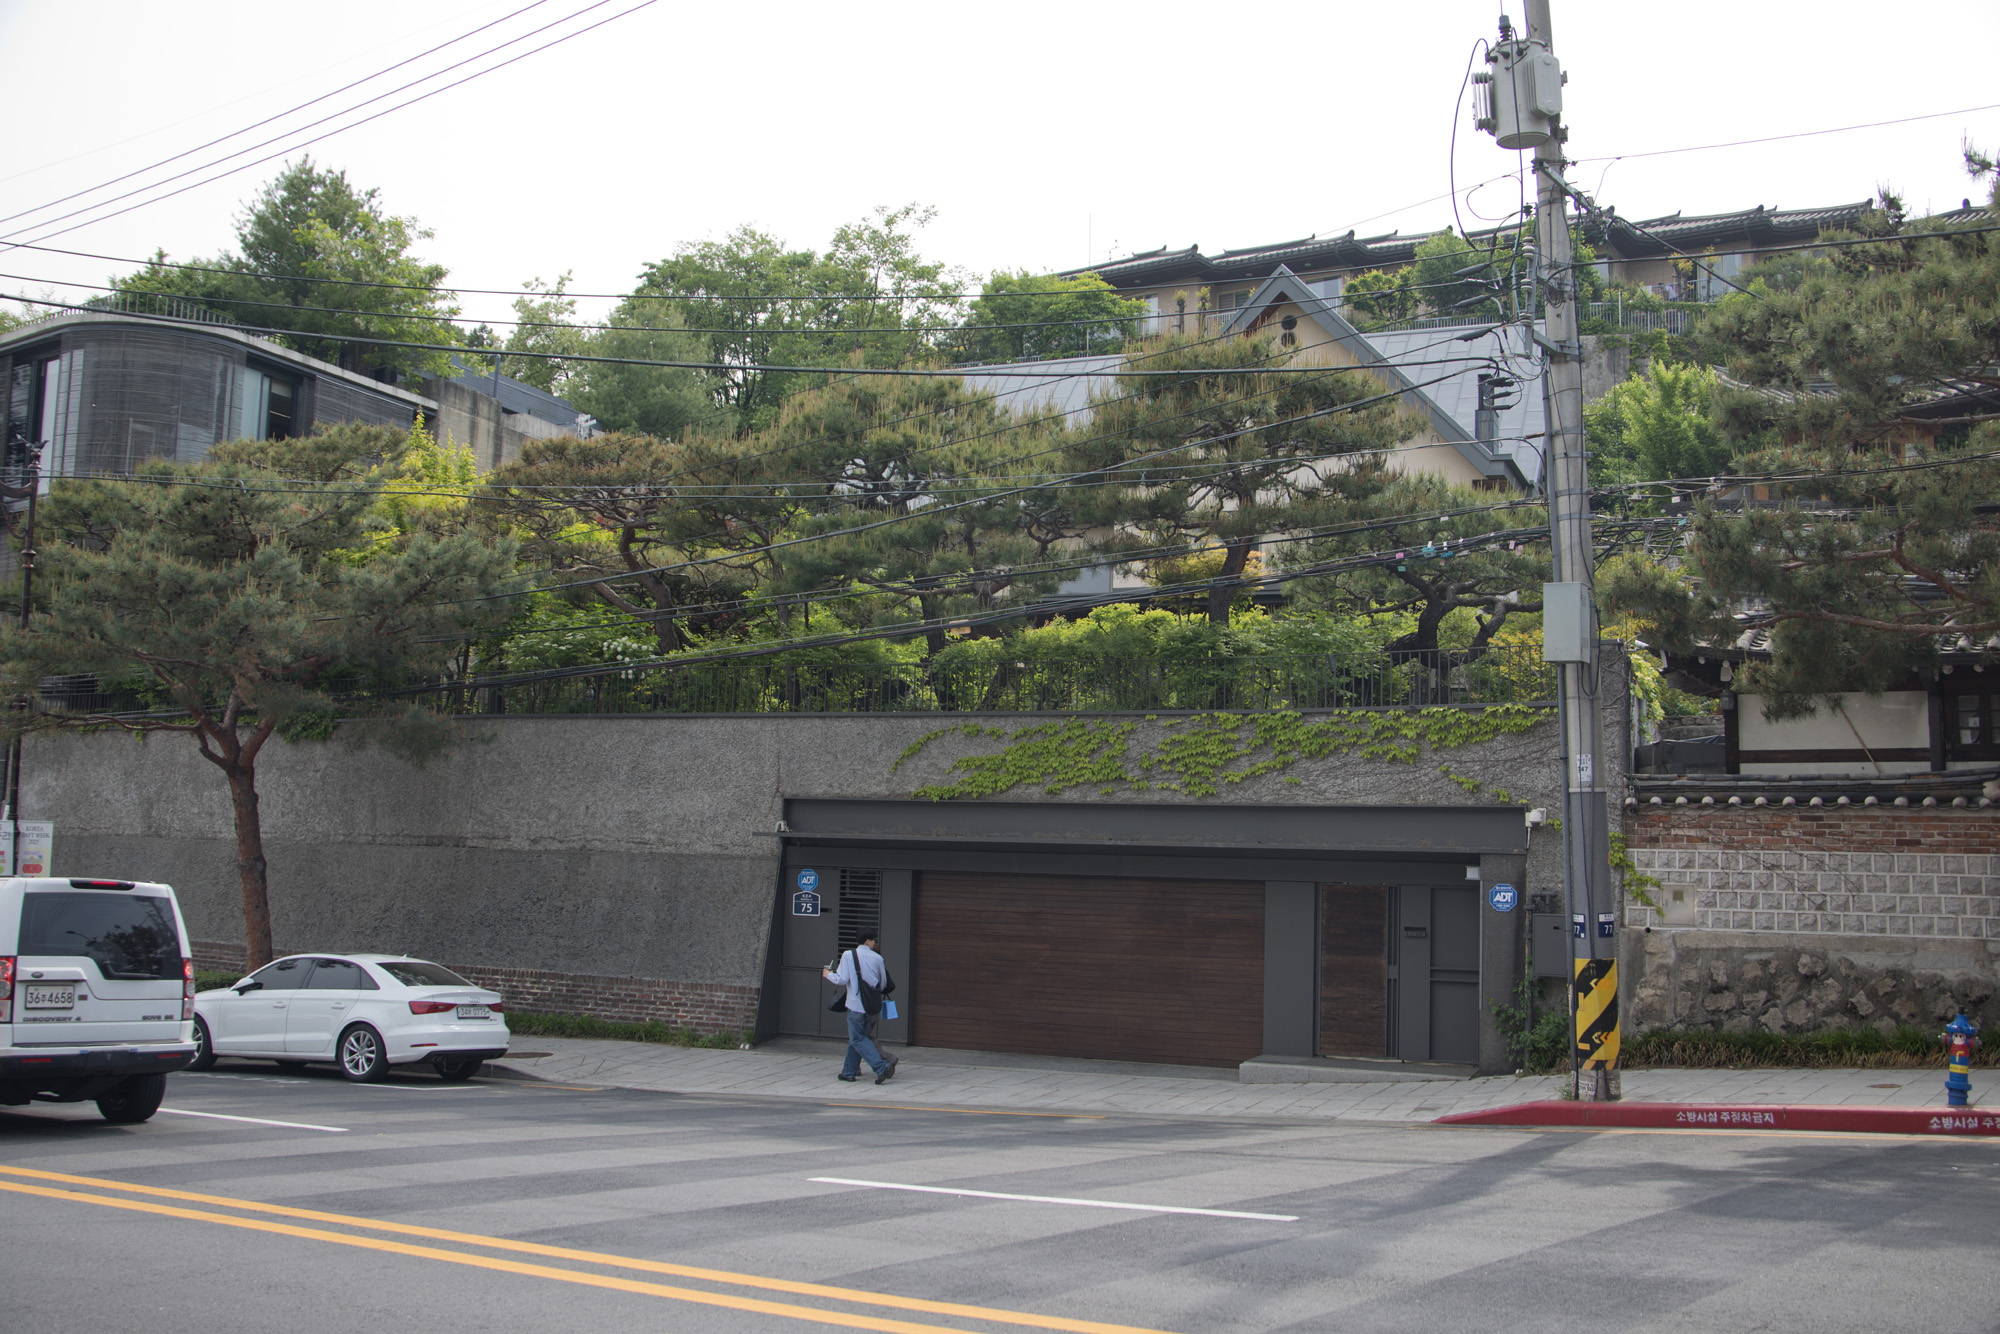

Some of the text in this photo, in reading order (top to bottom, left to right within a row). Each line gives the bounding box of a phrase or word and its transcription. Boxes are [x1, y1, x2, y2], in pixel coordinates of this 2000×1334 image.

[801, 876, 815, 885] ADT
[1493, 892, 1513, 903] ADT
[801, 903, 812, 913] 75
[1604, 924, 1613, 934] 77
[1676, 1111, 1774, 1124] 소방시설 주정차금지
[1929, 1116, 1978, 1128] 소방시설
